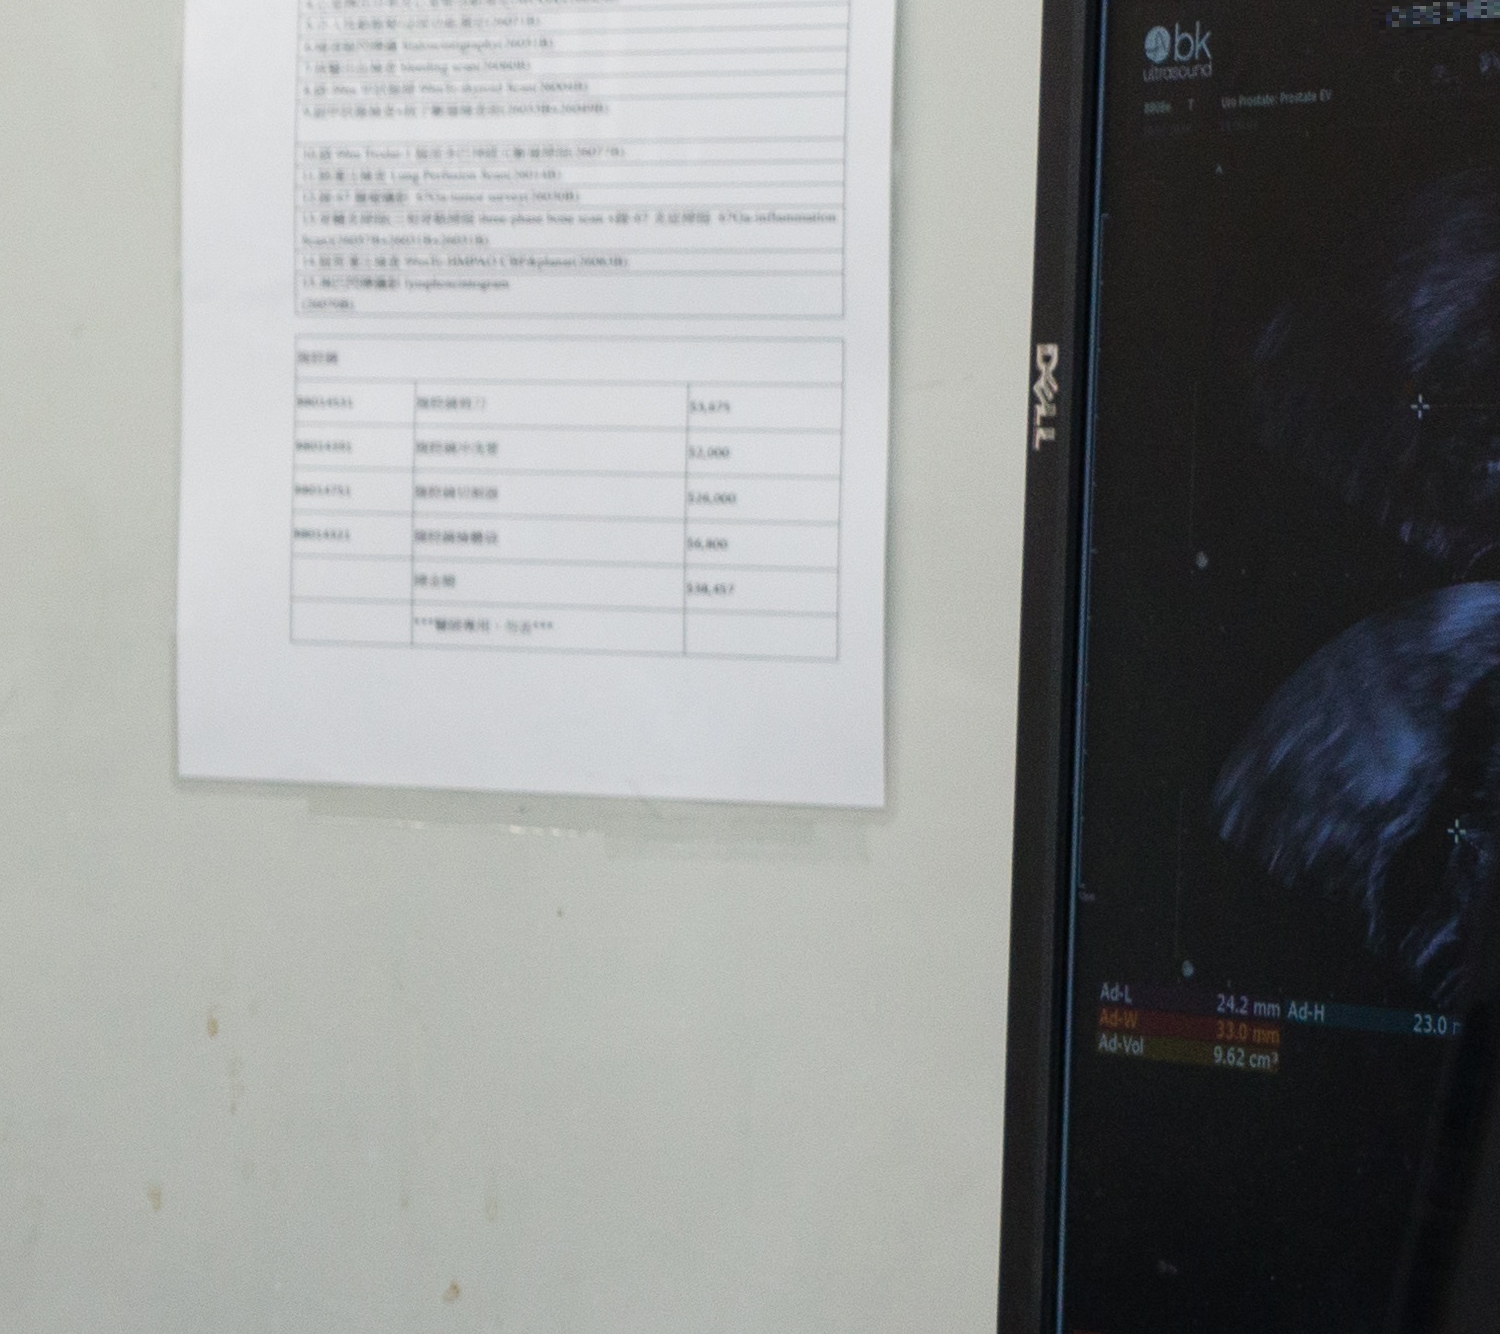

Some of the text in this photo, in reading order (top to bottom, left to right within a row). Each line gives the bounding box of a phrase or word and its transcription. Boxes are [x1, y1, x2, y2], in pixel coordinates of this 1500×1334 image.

[1173, 20, 1213, 62] bk
[1033, 343, 1059, 451] DELL
[1100, 981, 1281, 1018] Ad-L 24.2 mm
[1287, 1000, 1447, 1036] Ad-H 23.0
[1099, 1007, 1281, 1045] Ad-W 33.0 mm
[1098, 1032, 1145, 1055] Ad-Vol
[1212, 1046, 1246, 1069] 9.62
